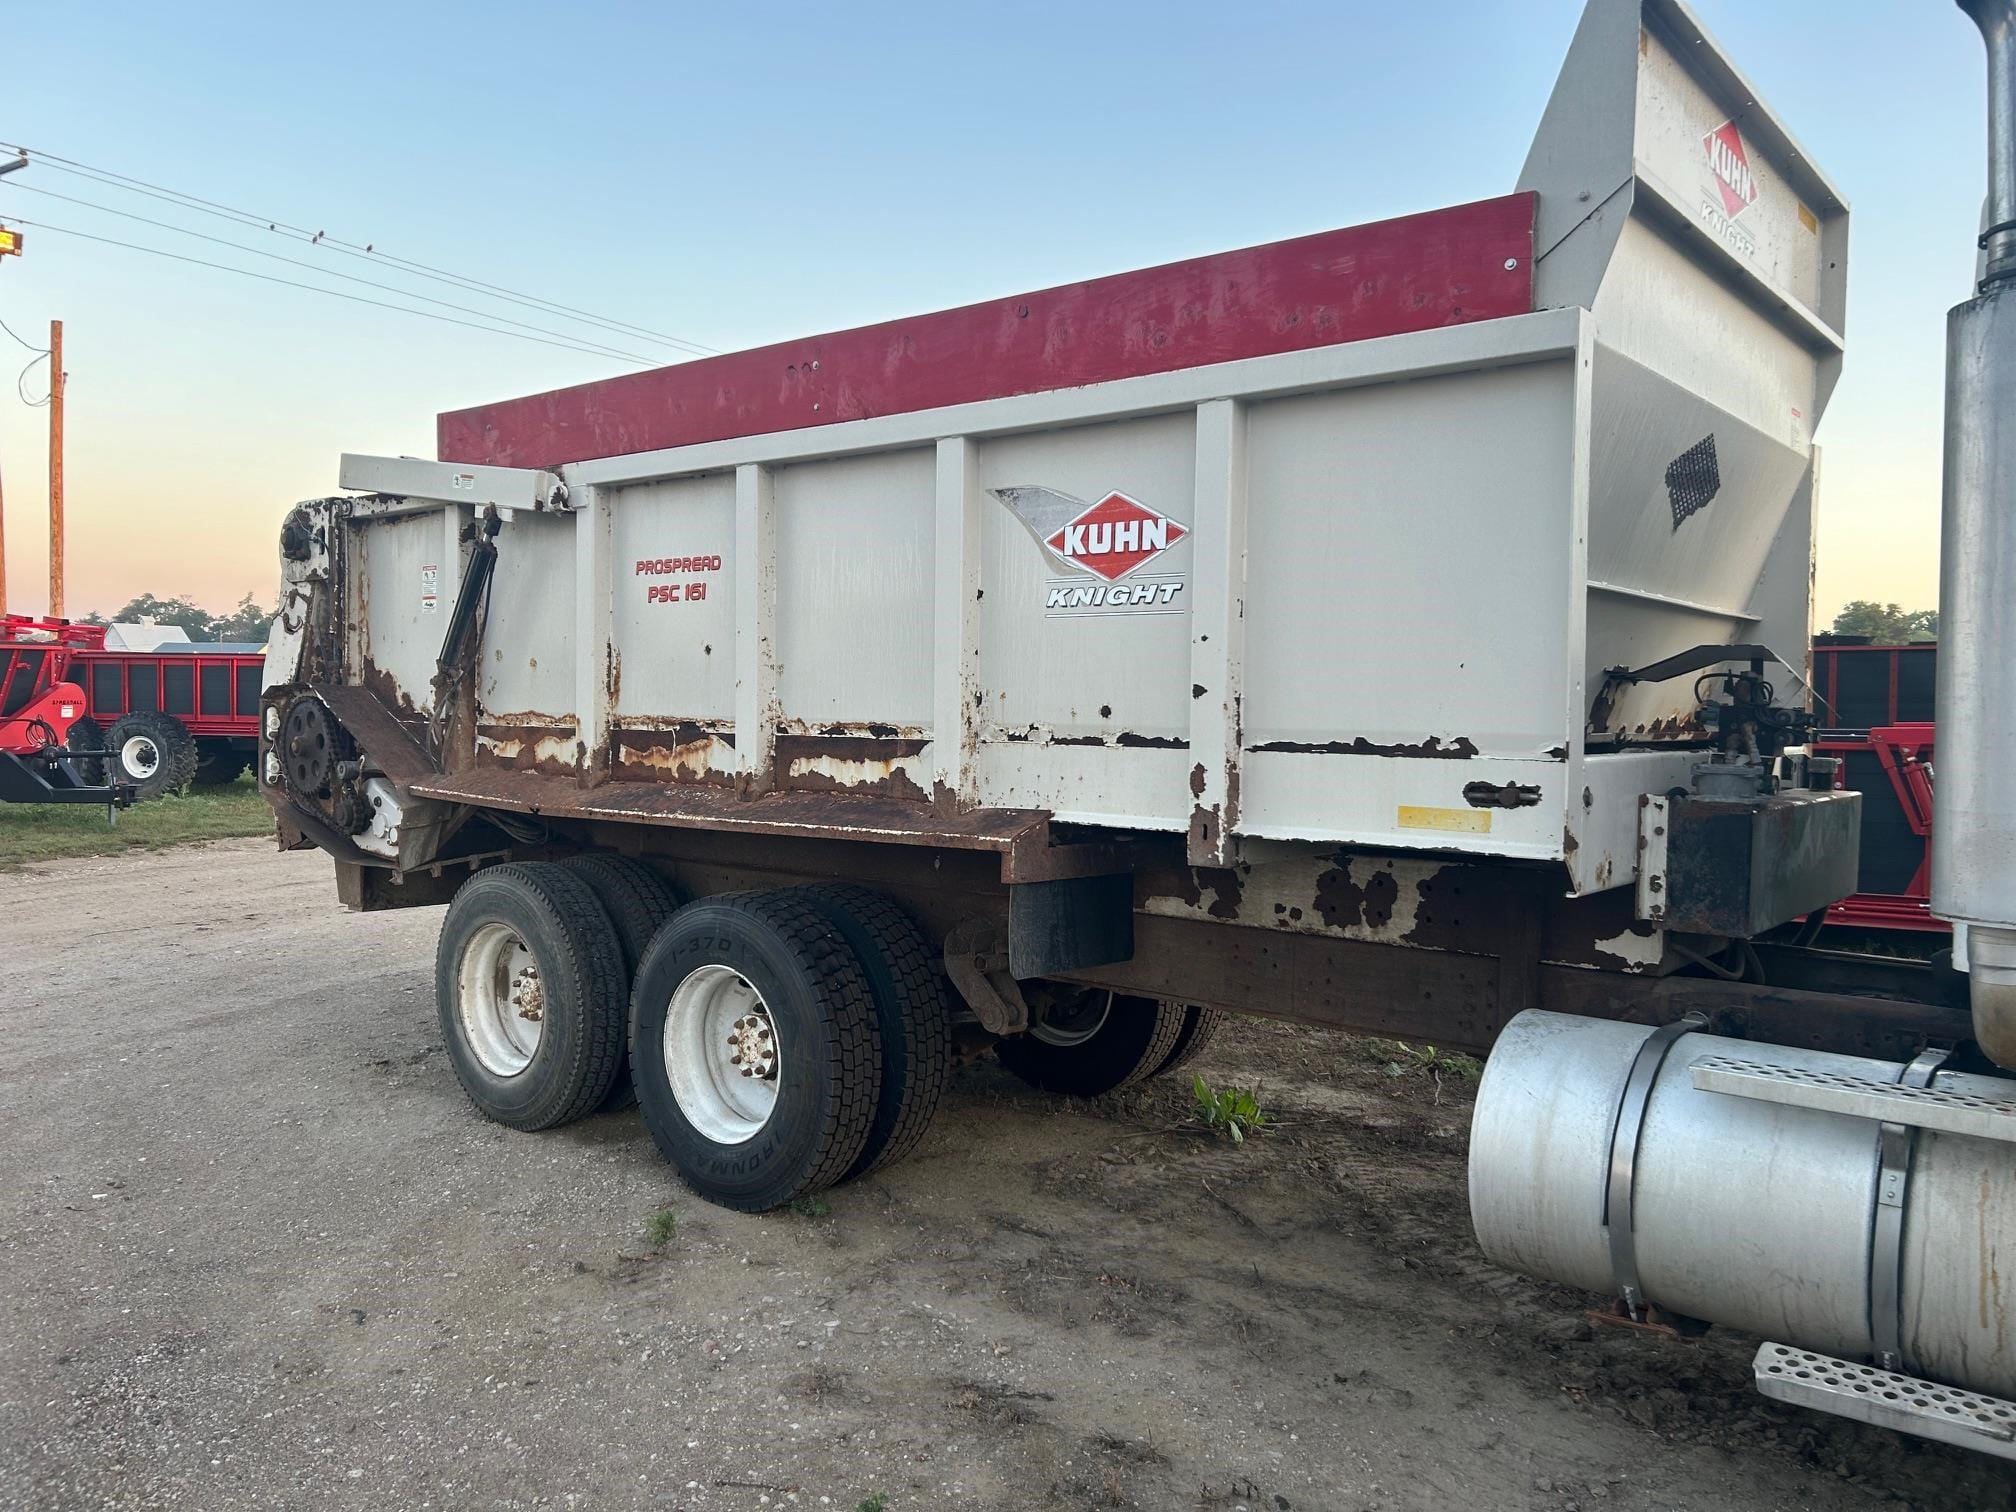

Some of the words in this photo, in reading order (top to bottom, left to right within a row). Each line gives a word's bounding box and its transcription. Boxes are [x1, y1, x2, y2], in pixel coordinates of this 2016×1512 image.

[1711, 132, 1751, 203] KUHN
[1701, 202, 1755, 257] KNIGHT
[1063, 518, 1167, 556] KUHN
[636, 555, 721, 575] PROSPREAD
[648, 585, 680, 603] PSC
[685, 583, 707, 601] 161
[1046, 583, 1183, 608] KNIGHT
[685, 1130, 782, 1177] IRONMA
